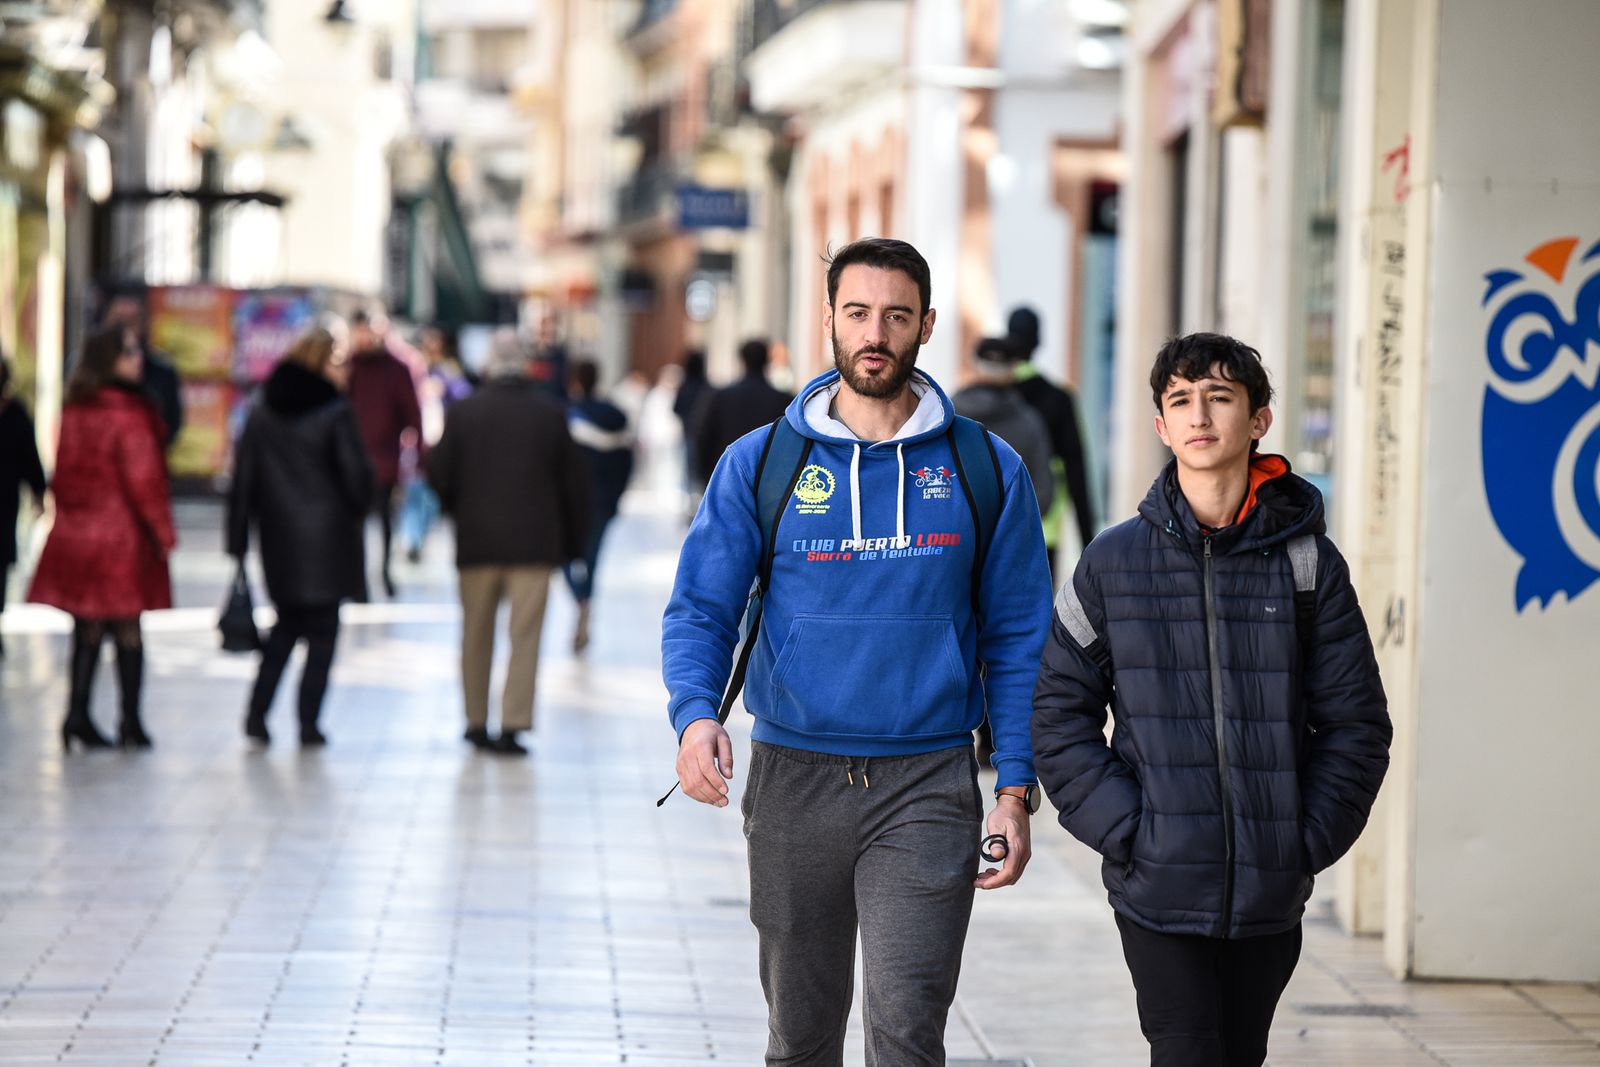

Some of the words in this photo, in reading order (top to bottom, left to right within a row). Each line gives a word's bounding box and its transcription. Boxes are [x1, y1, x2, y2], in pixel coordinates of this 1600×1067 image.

[923, 487, 952, 495] CABEZA
[792, 539, 835, 552] CLUB
[916, 533, 961, 547] LOBO
[807, 551, 852, 562] Sierra
[859, 550, 877, 561] de
